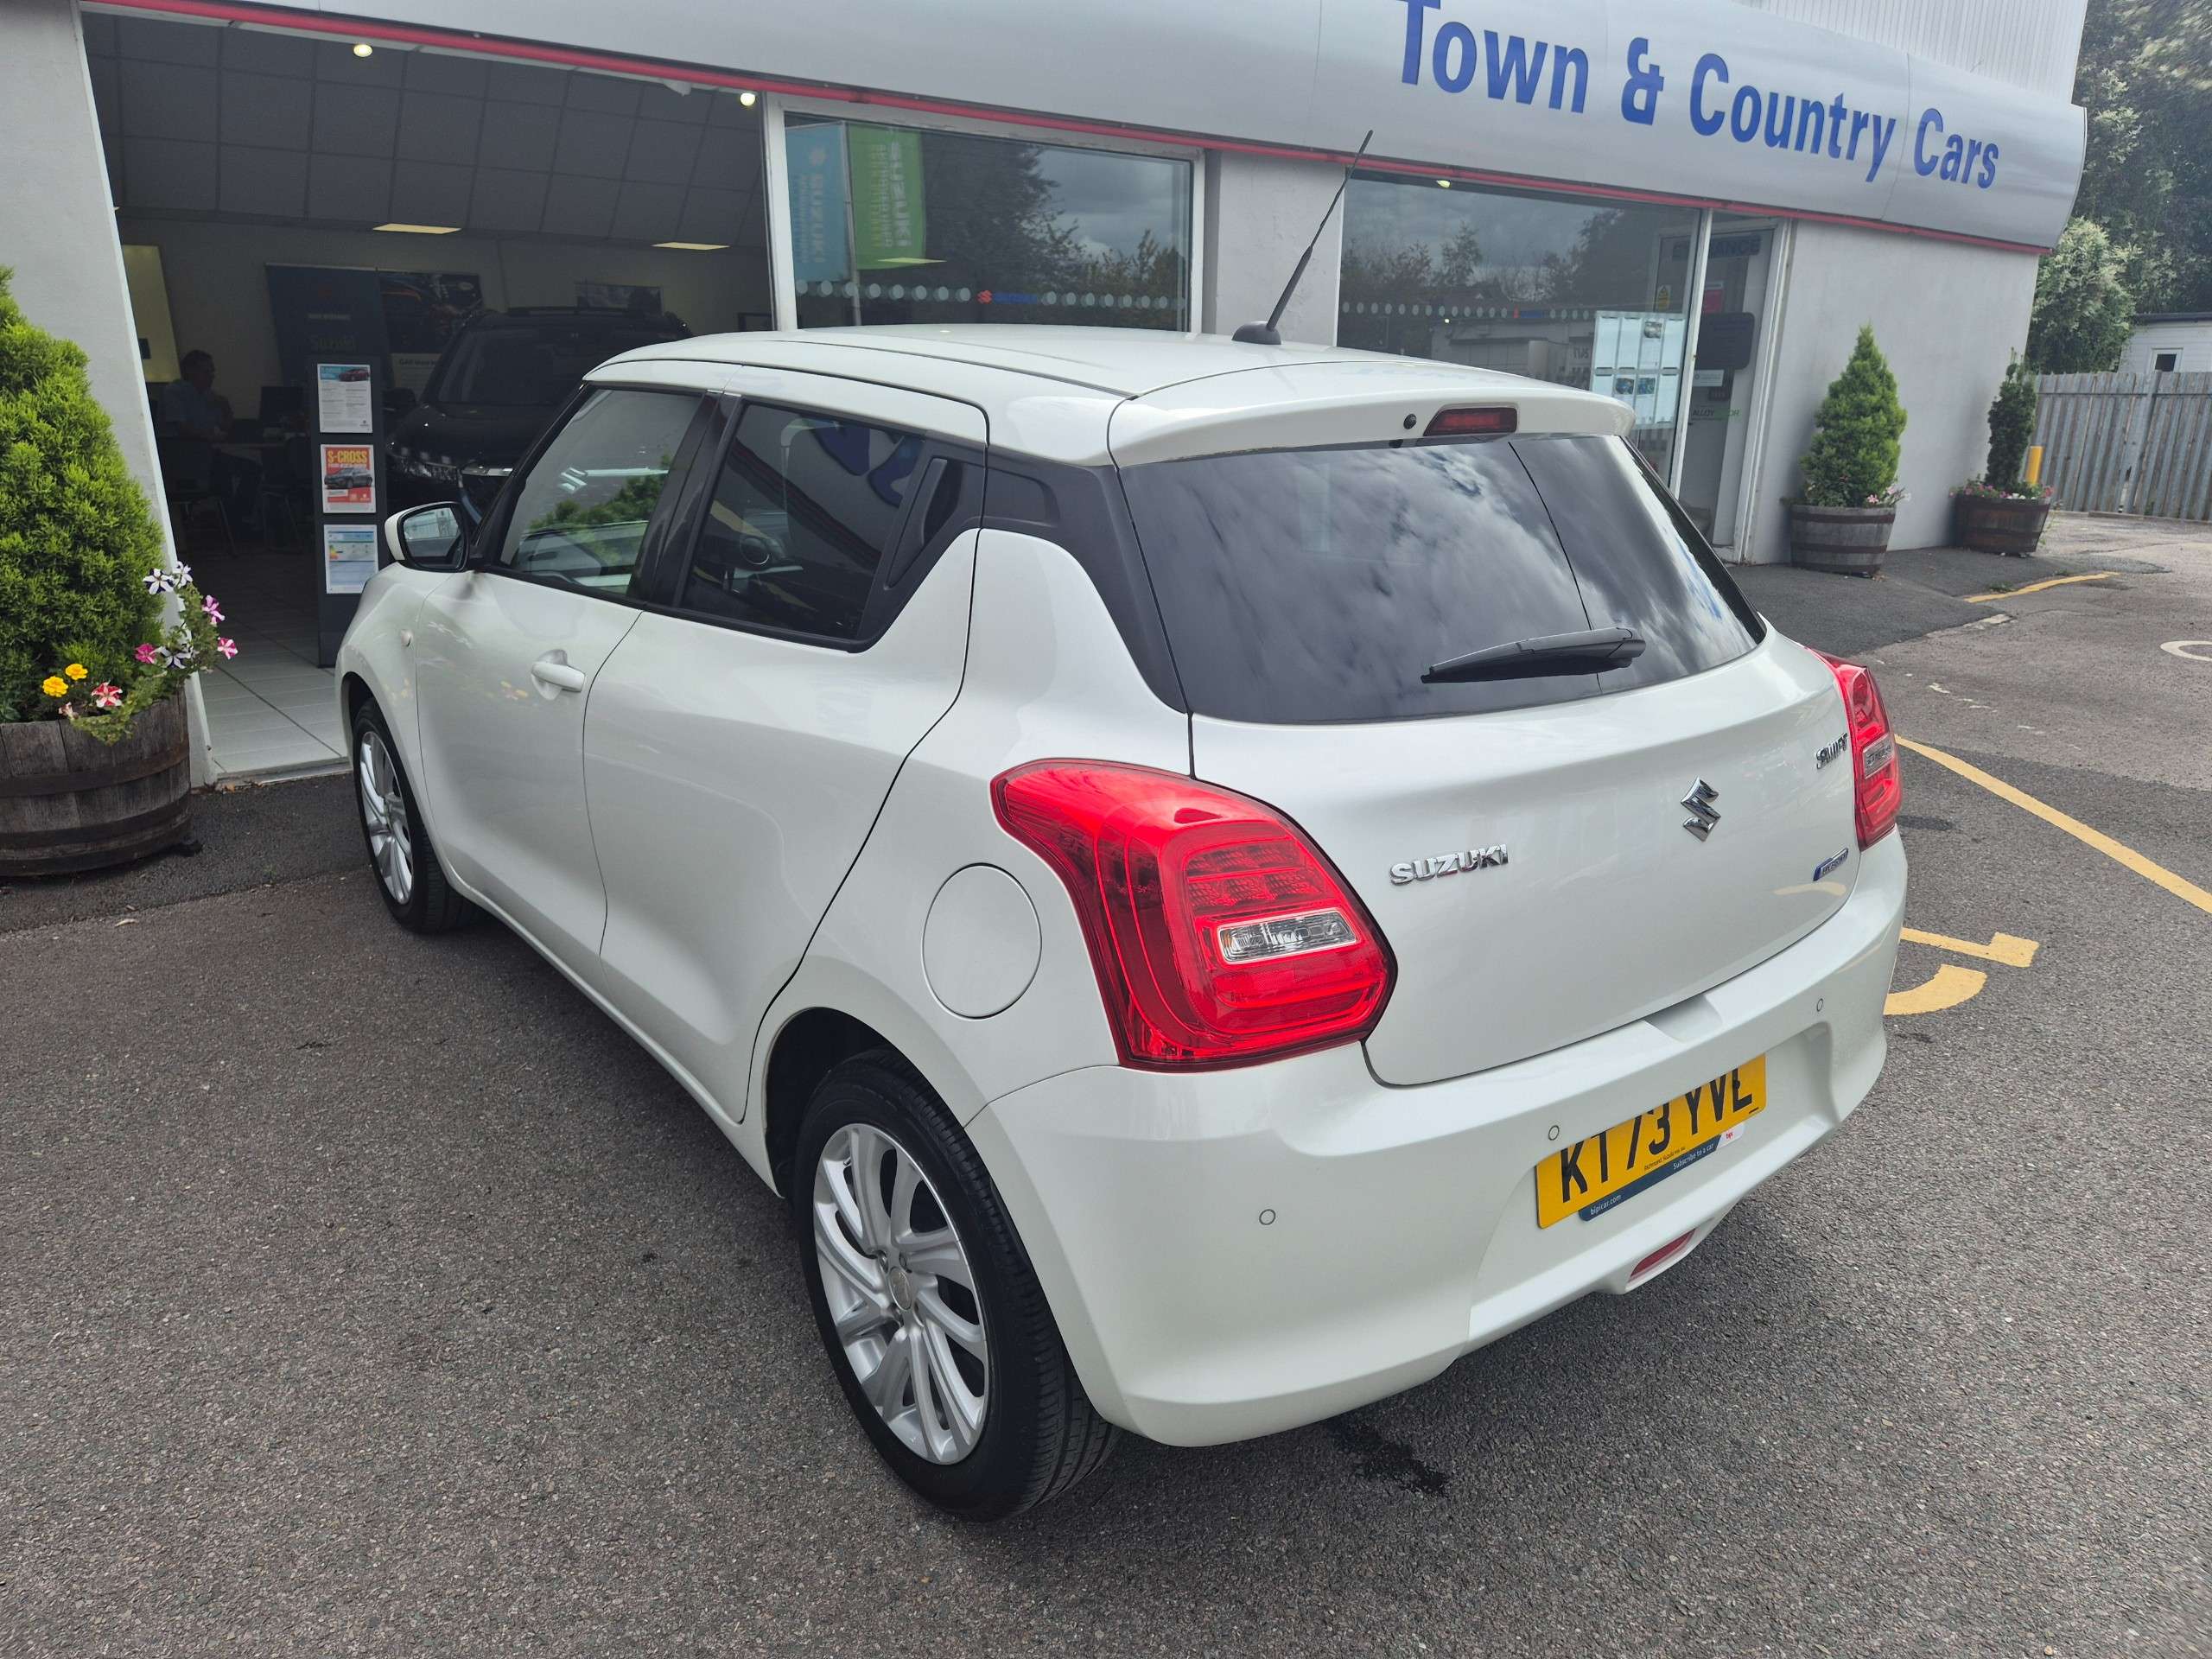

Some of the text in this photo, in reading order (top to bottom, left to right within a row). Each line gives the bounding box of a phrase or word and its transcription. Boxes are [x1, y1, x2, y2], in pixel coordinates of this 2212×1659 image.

[1397, 0, 1999, 189] Town & Country Cars
[327, 449, 367, 464] S-CROSS
[1389, 843, 1510, 887] SUZUKI
[1673, 1152, 1697, 1170] Subscribe
[1696, 1147, 1703, 1157] to
[1590, 1194, 1622, 1216] bipicar.com
